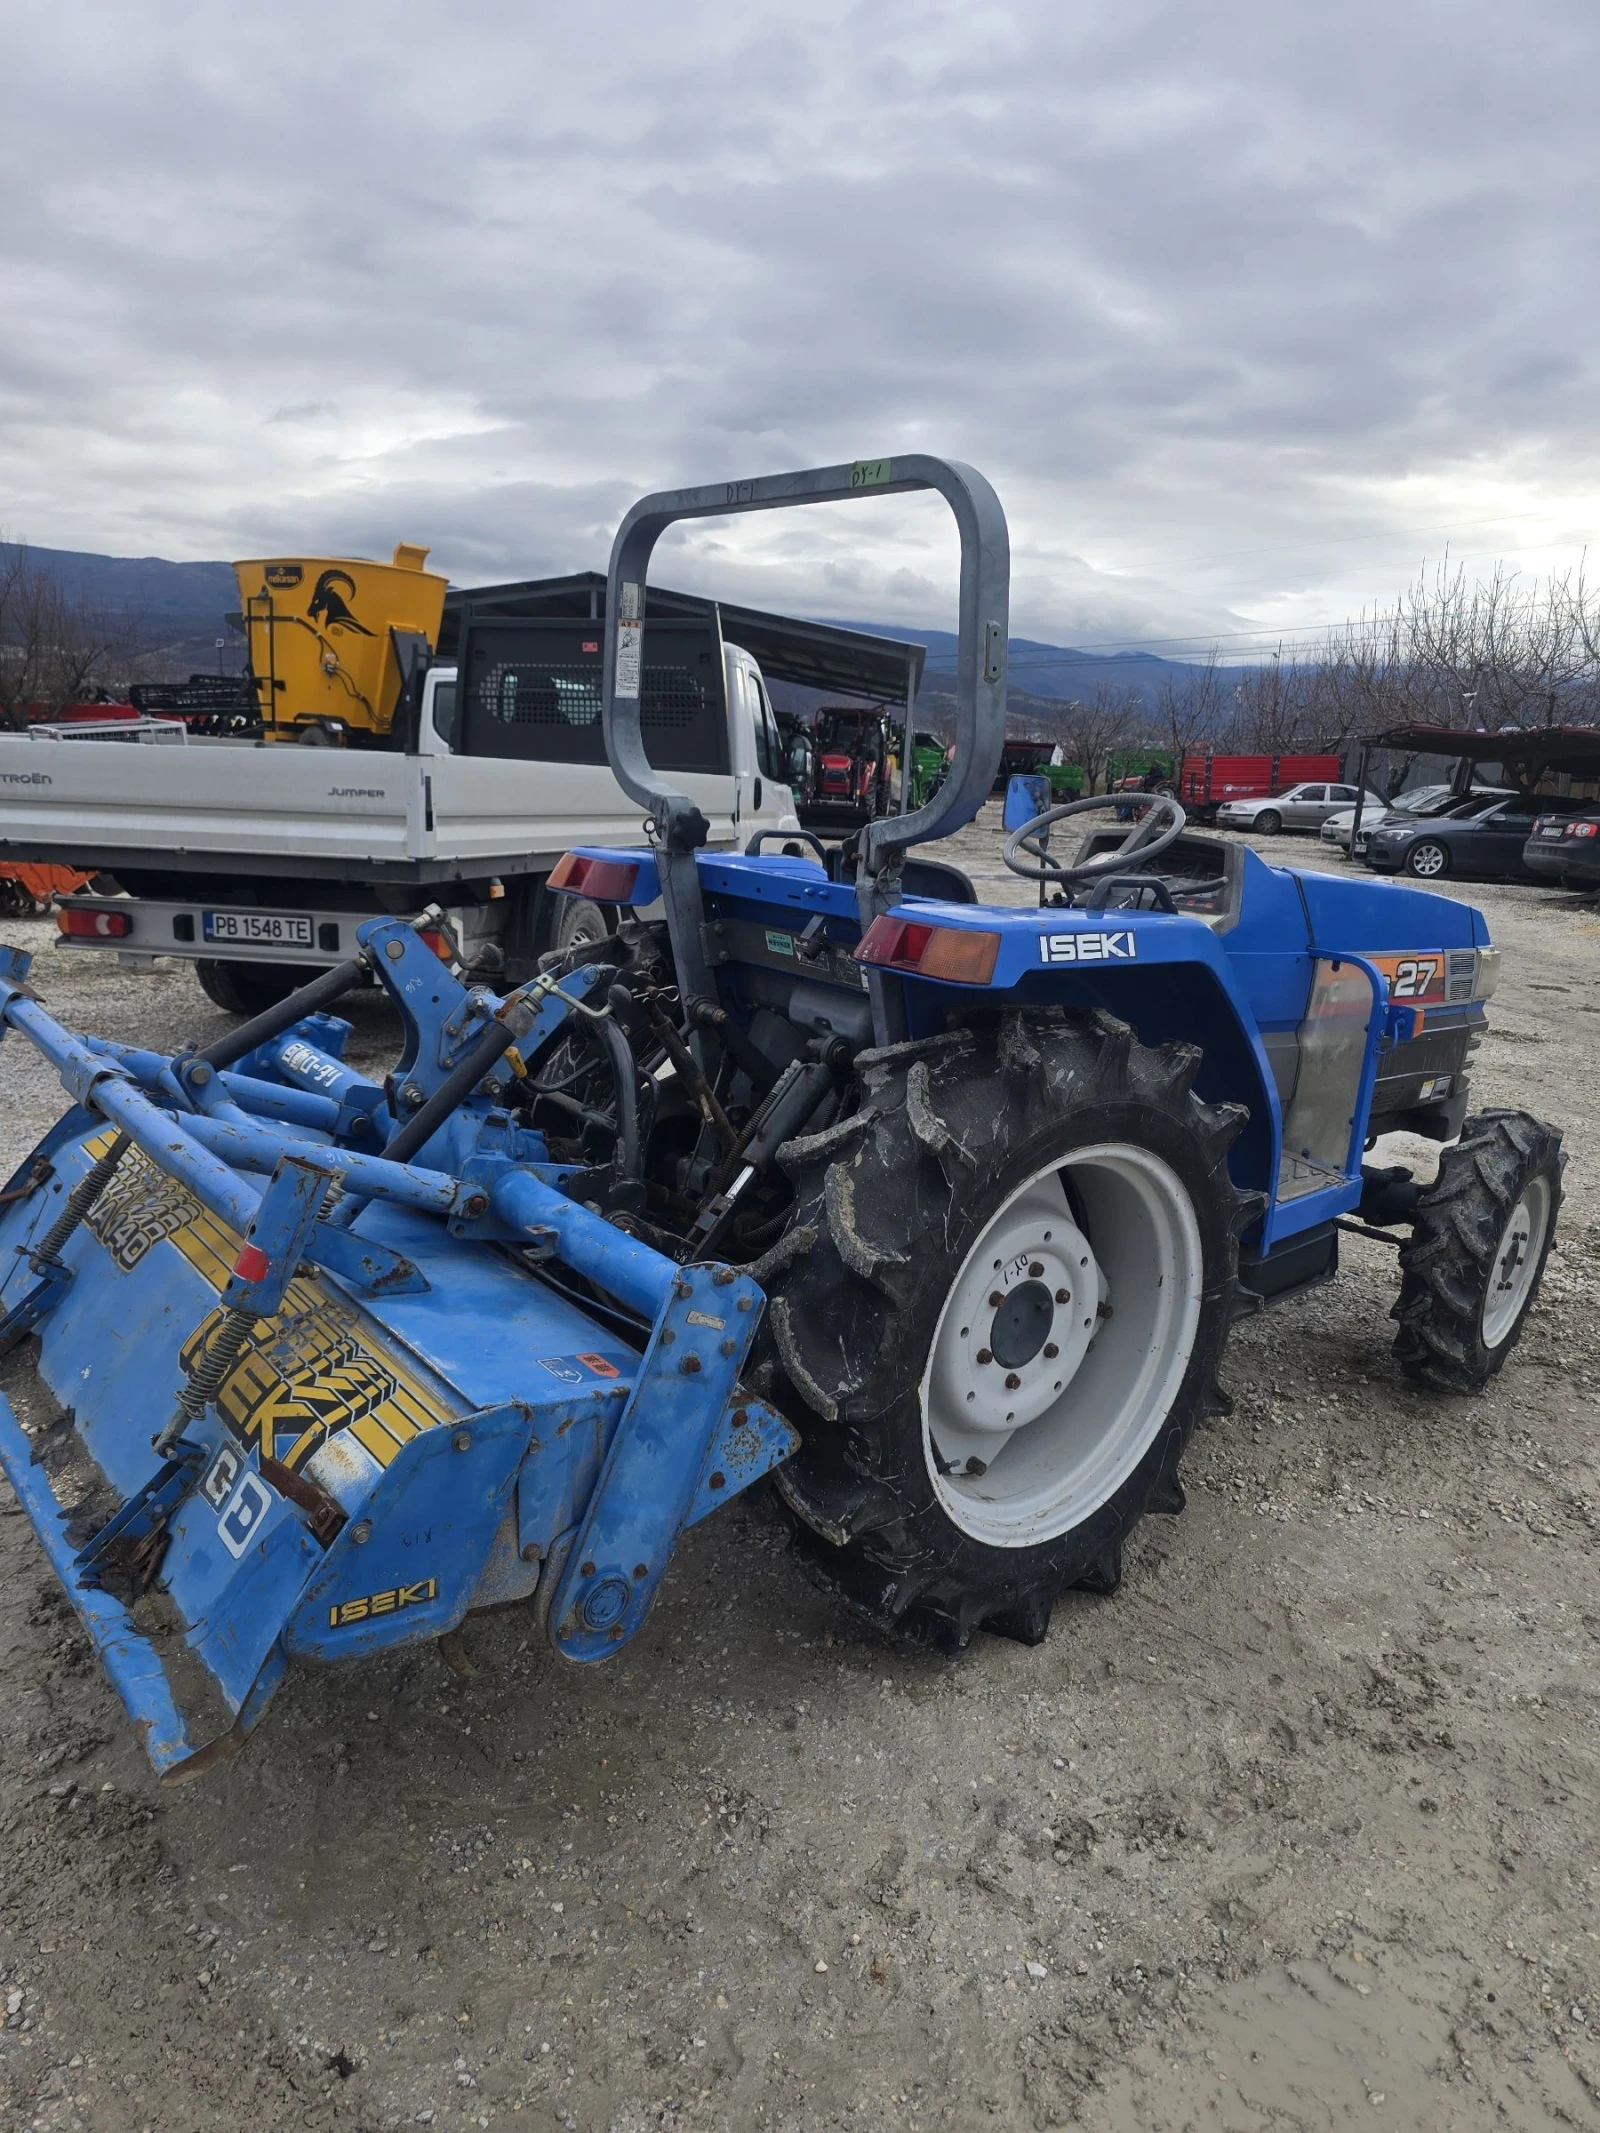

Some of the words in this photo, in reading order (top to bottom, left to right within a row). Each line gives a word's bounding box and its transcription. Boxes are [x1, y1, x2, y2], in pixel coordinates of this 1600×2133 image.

[215, 916, 238, 935] PB
[243, 917, 282, 938] 1548
[285, 920, 308, 940] TE
[1039, 931, 1136, 963] ISEKI
[1393, 959, 1438, 998] 27
[329, 1576, 437, 1627] ISEKI
